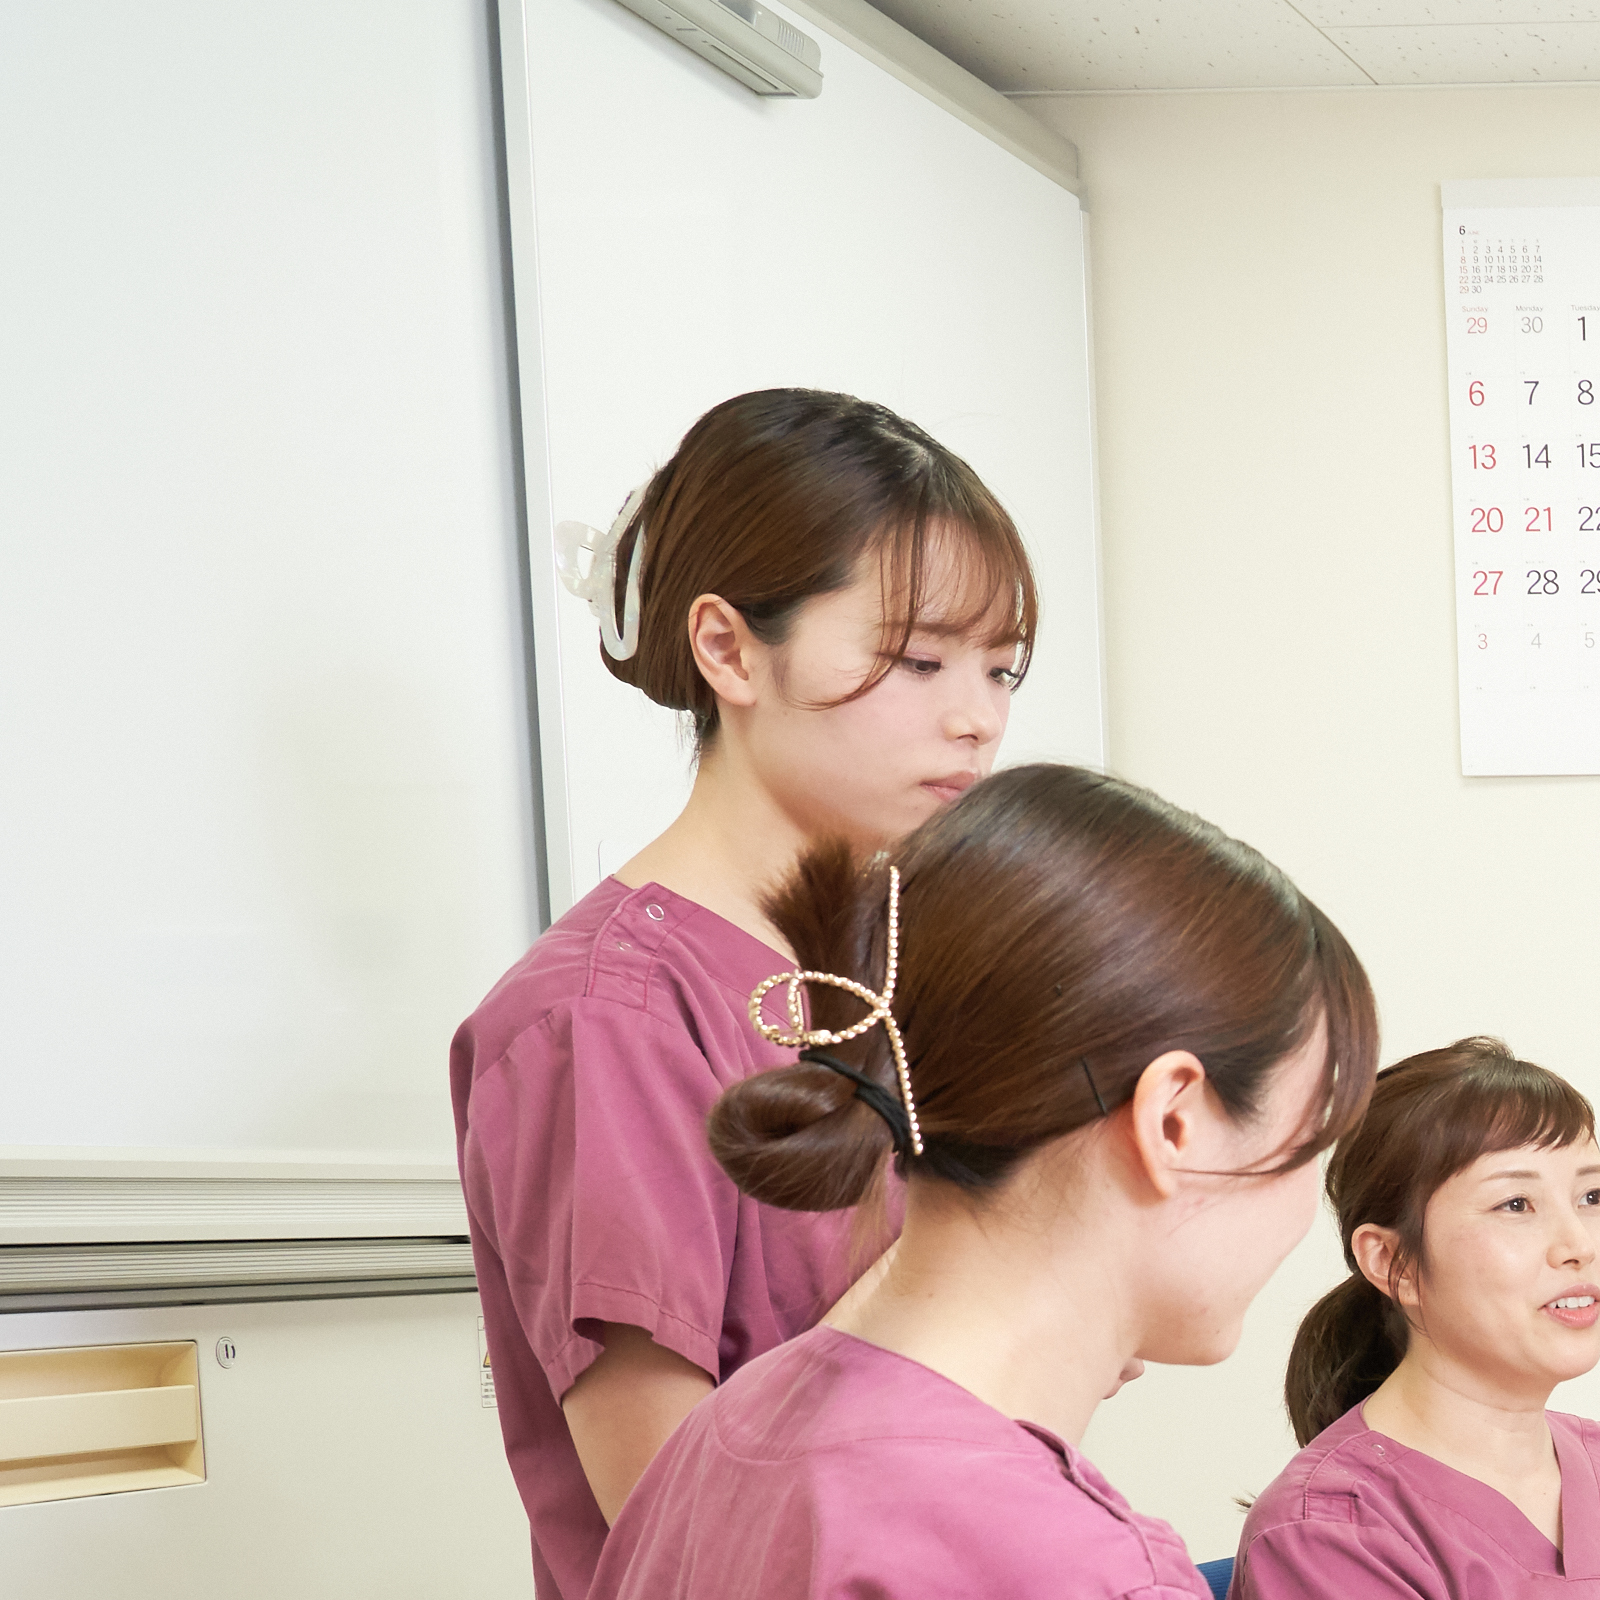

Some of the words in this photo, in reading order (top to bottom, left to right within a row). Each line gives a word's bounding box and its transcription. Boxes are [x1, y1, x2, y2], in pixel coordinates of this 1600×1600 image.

[1459, 226, 1466, 235] 6
[1461, 305, 1489, 314] Sunday
[1515, 305, 1544, 313] Monday
[1571, 304, 1600, 312] Tuesday
[1467, 317, 1487, 334] 29
[1521, 316, 1543, 333] 30
[1578, 316, 1586, 341] 1
[1469, 381, 1484, 406] 6
[1524, 381, 1539, 405] 7
[1578, 380, 1594, 405] 8
[1469, 444, 1496, 470] 13
[1523, 444, 1551, 468] 14
[1471, 507, 1503, 533] 20
[1525, 507, 1551, 532] 21
[1473, 571, 1503, 595] 27
[1527, 570, 1559, 595] 28
[1478, 633, 1488, 650] 3
[1531, 633, 1541, 648] 4
[1585, 632, 1595, 648] 5
